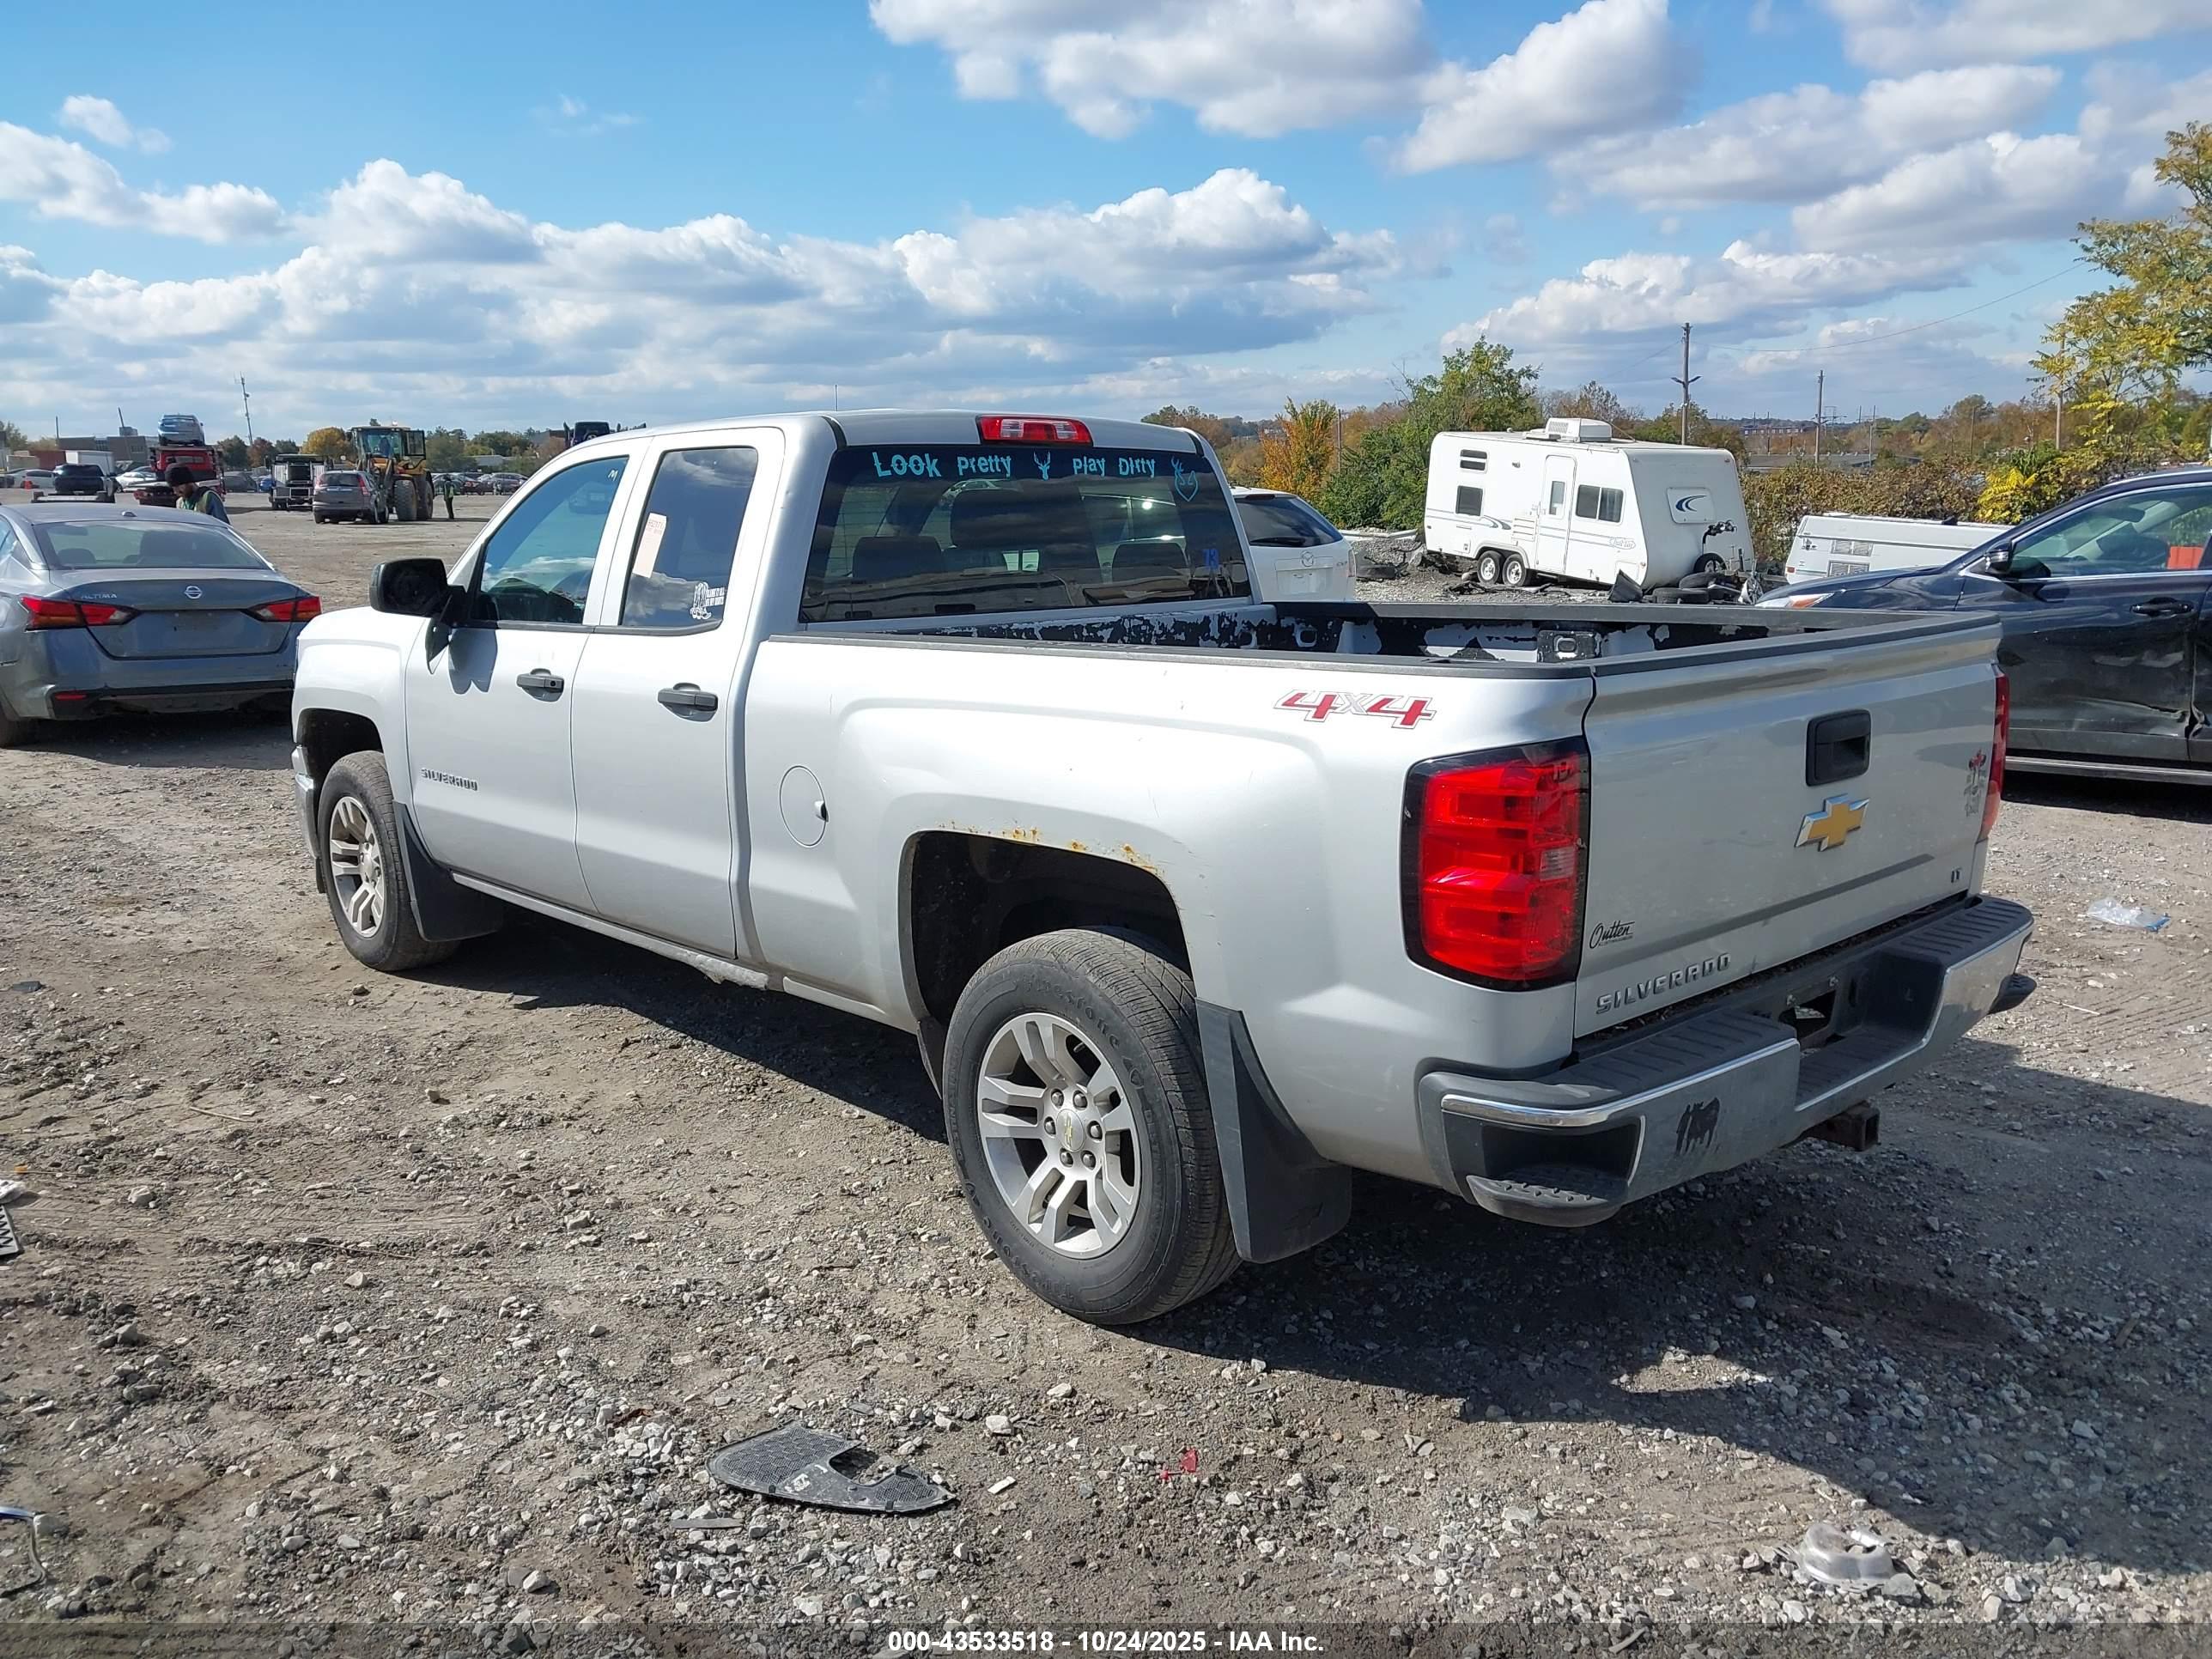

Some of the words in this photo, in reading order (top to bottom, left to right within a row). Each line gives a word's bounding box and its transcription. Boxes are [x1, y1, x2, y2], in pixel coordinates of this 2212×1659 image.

[872, 452, 942, 477] Look
[1589, 921, 1635, 949] Outten
[1595, 952, 1731, 1014] SILVERADO
